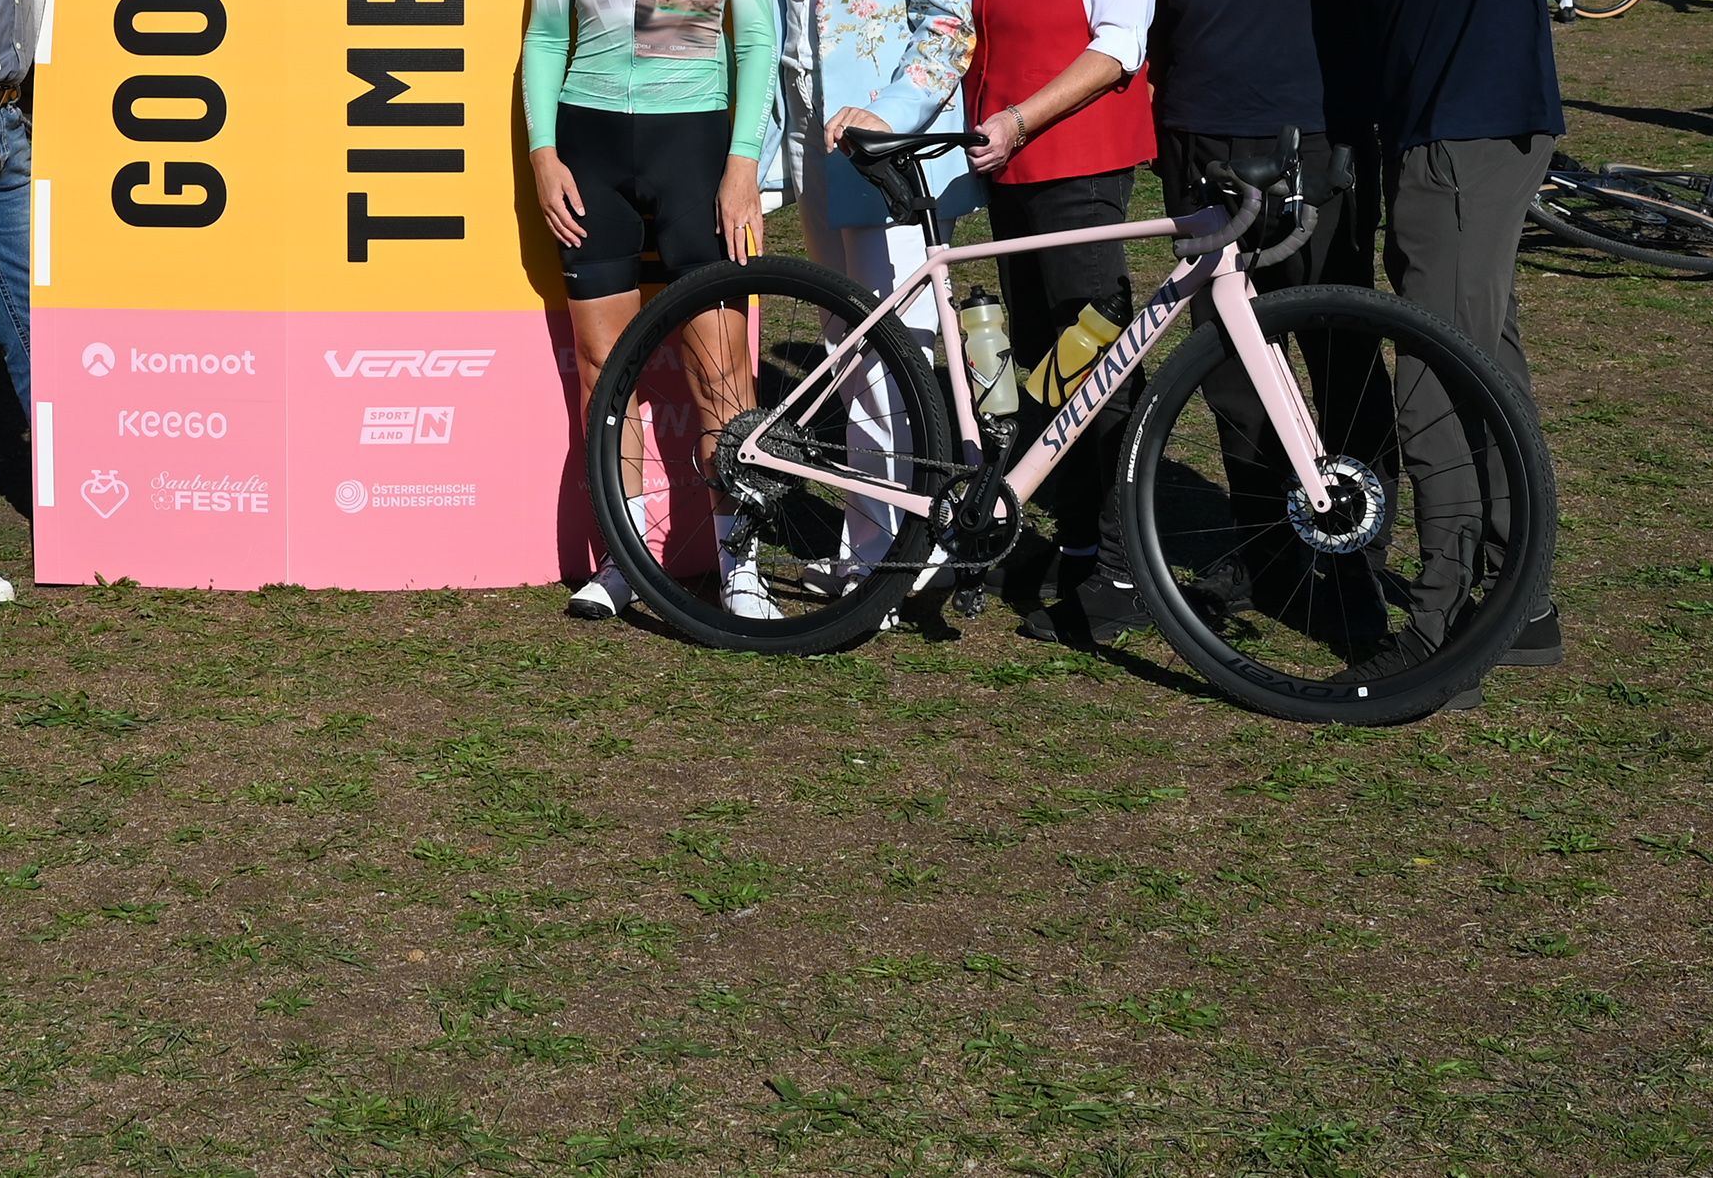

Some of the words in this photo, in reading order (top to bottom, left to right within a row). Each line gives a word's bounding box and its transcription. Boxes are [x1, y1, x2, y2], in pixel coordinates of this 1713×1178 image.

[755, 101, 772, 140] COLORS
[130, 347, 256, 375] komoot
[323, 349, 497, 378] VERGE
[1042, 277, 1181, 461] SPECIALIZED
[369, 411, 410, 420] SPORT
[764, 401, 789, 426] CRUX
[370, 431, 403, 440] LAND
[150, 471, 269, 495] Sauberhafte
[372, 482, 476, 495] ÖSTERREICHISCHE
[175, 491, 269, 513] FESTE
[372, 495, 476, 508] BUNDESFORSTE
